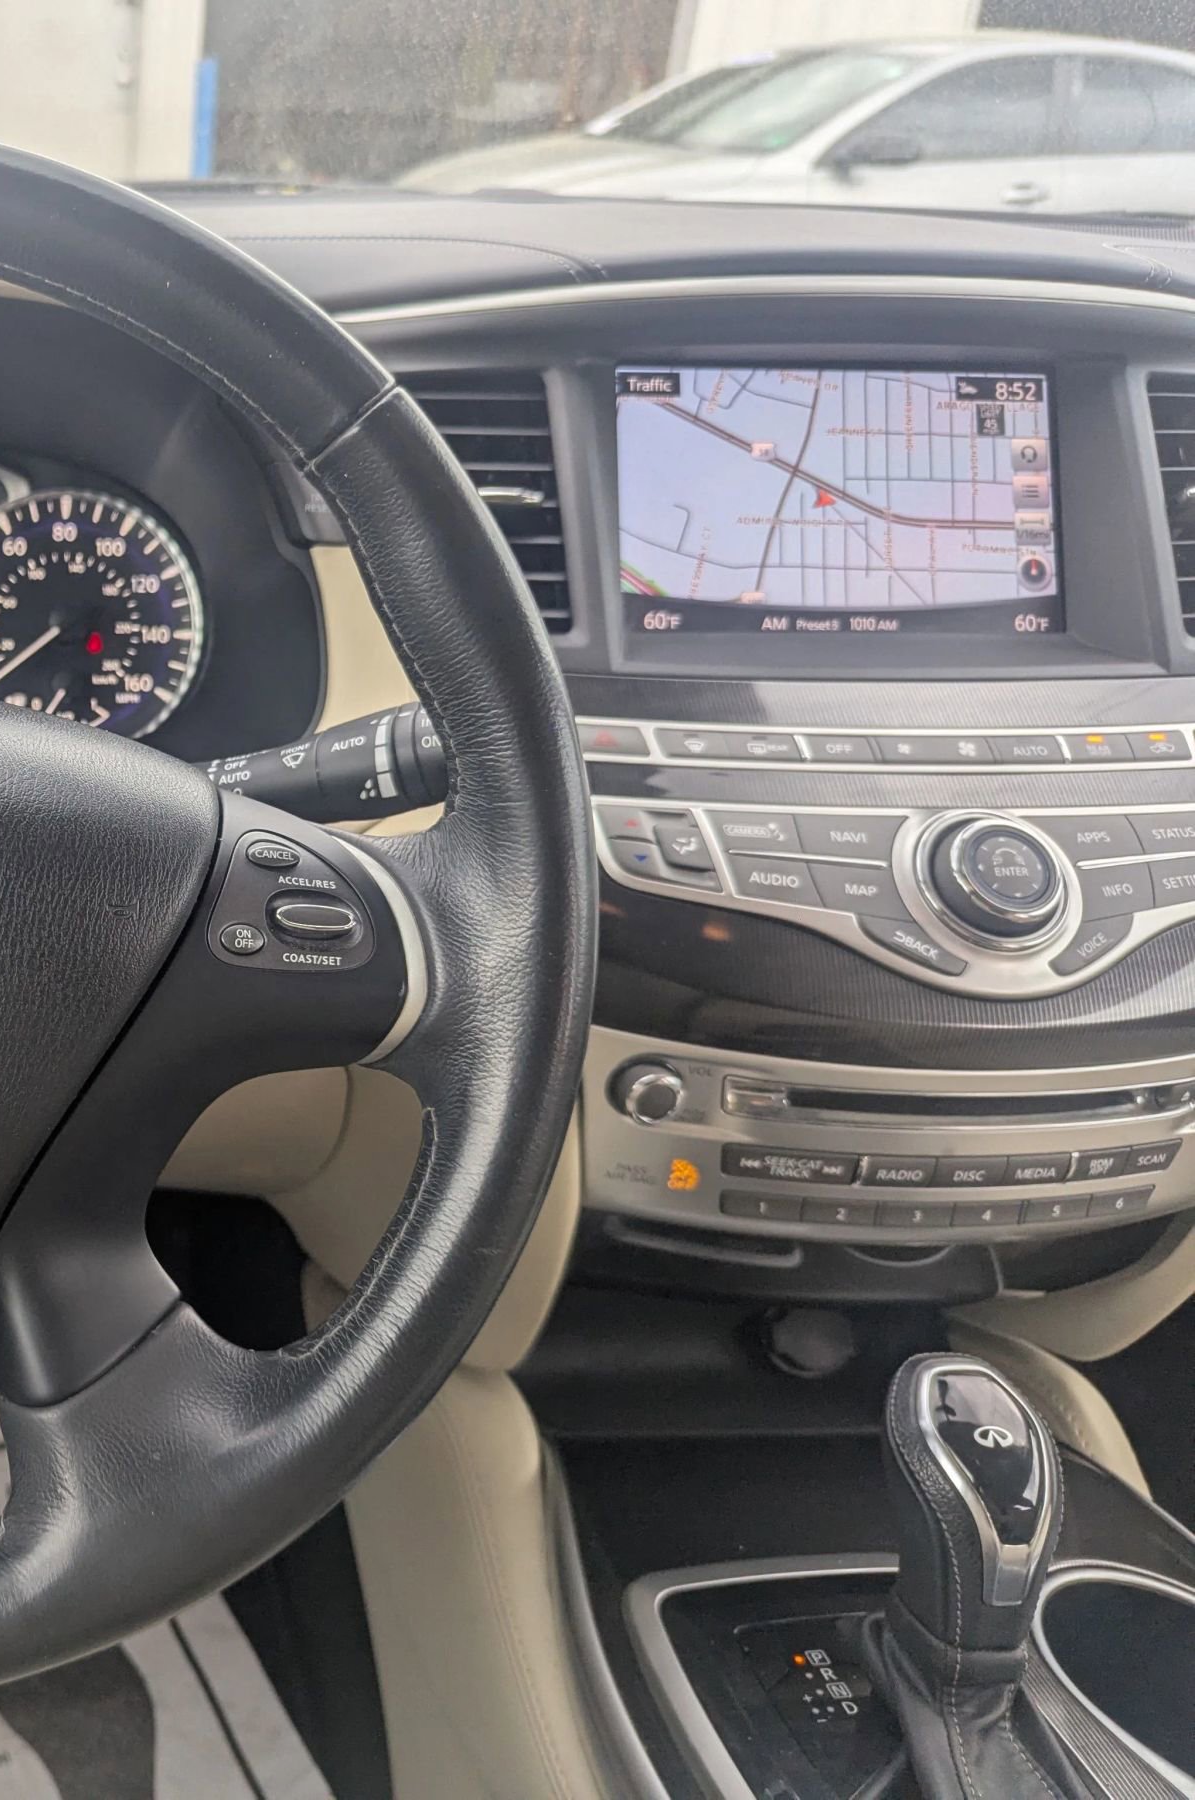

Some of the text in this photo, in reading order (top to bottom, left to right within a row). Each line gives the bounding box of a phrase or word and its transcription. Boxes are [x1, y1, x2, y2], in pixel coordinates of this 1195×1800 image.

[627, 378, 671, 394] Traffic
[996, 382, 1036, 401] 8:52
[984, 419, 997, 428] 45
[52, 521, 78, 542] 80
[2, 537, 28, 556] 60
[95, 537, 126, 557] 100
[131, 574, 160, 594] 120
[761, 616, 788, 631] AM
[796, 619, 831, 631] Preset
[849, 616, 876, 632] 1010
[877, 619, 899, 632] AM
[141, 625, 171, 644] 140
[124, 673, 154, 693] 160
[331, 735, 367, 752] AUTO
[421, 735, 442, 748] ON
[826, 743, 852, 754] OFF
[280, 742, 311, 756] FRONT
[1013, 746, 1048, 756] AUTO
[224, 760, 247, 771] OFF
[219, 770, 251, 786] AUTO
[830, 831, 867, 843] NAVI
[1076, 831, 1111, 844] APPS
[1152, 827, 1195, 840] STATUS
[255, 849, 294, 861] CANCEL
[994, 867, 1029, 877] ENTER
[278, 875, 337, 889] ACCEL/RES
[749, 872, 800, 888] AUDIO
[845, 883, 877, 897] MAP
[1102, 884, 1134, 897] INFO
[236, 929, 251, 938] ON
[235, 938, 254, 948] OFF
[904, 936, 939, 960] BACK
[1077, 931, 1108, 958] VOICE
[282, 952, 342, 966] COAST/SET
[1137, 1153, 1167, 1166] SCAN
[769, 1167, 810, 1179] TRACK
[876, 1169, 923, 1181] RADIO
[953, 1170, 985, 1182] DISC
[1015, 1167, 1056, 1180] MEDIA
[759, 1197, 1124, 1222] 1 2 3 4 5 6
[819, 1667, 838, 1681] R
[841, 1701, 858, 1715] D
